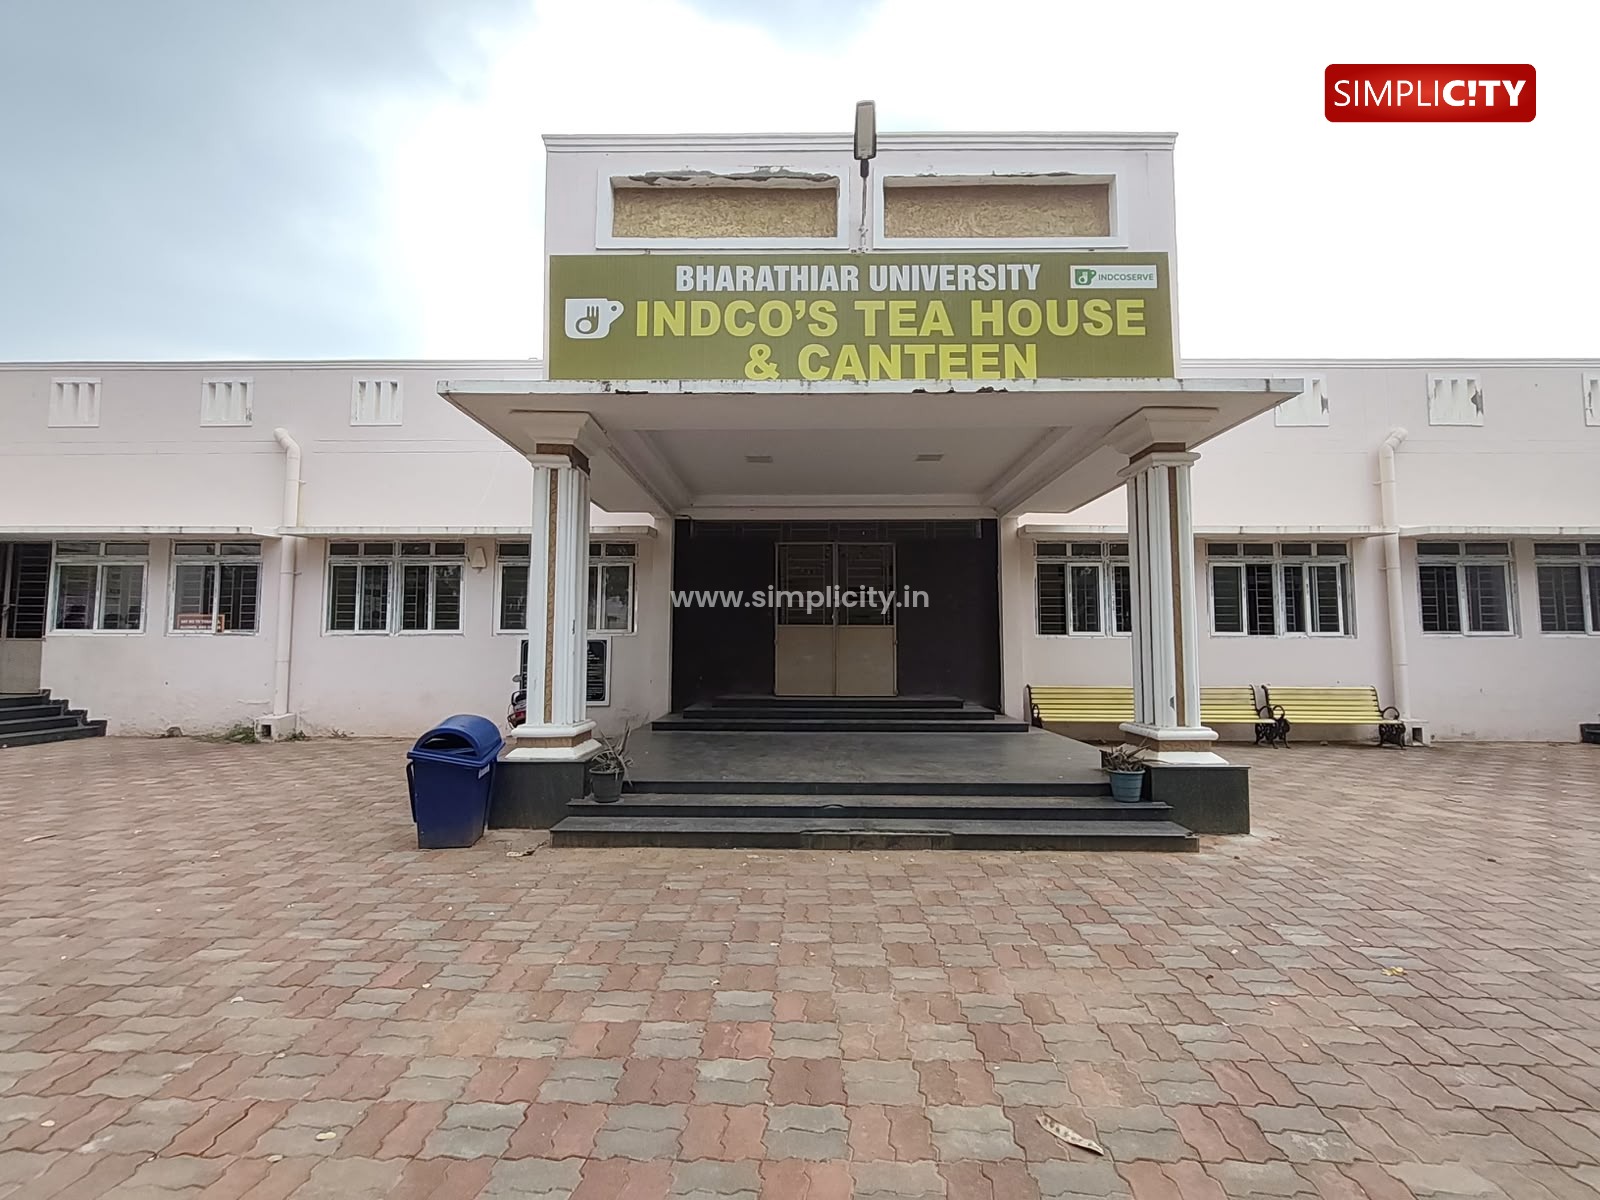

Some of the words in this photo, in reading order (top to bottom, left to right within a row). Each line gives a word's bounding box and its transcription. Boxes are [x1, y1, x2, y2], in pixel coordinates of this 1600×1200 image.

[675, 264, 860, 292] BHARATHIAR
[869, 263, 1041, 292] UNIVERSITY
[1098, 273, 1154, 281] INDCOSERVE
[636, 299, 838, 337] INDCO'S
[854, 300, 954, 337] TEA
[971, 298, 1146, 337] HOUSE
[744, 343, 780, 380] &
[798, 343, 1037, 380] CANTEEN
